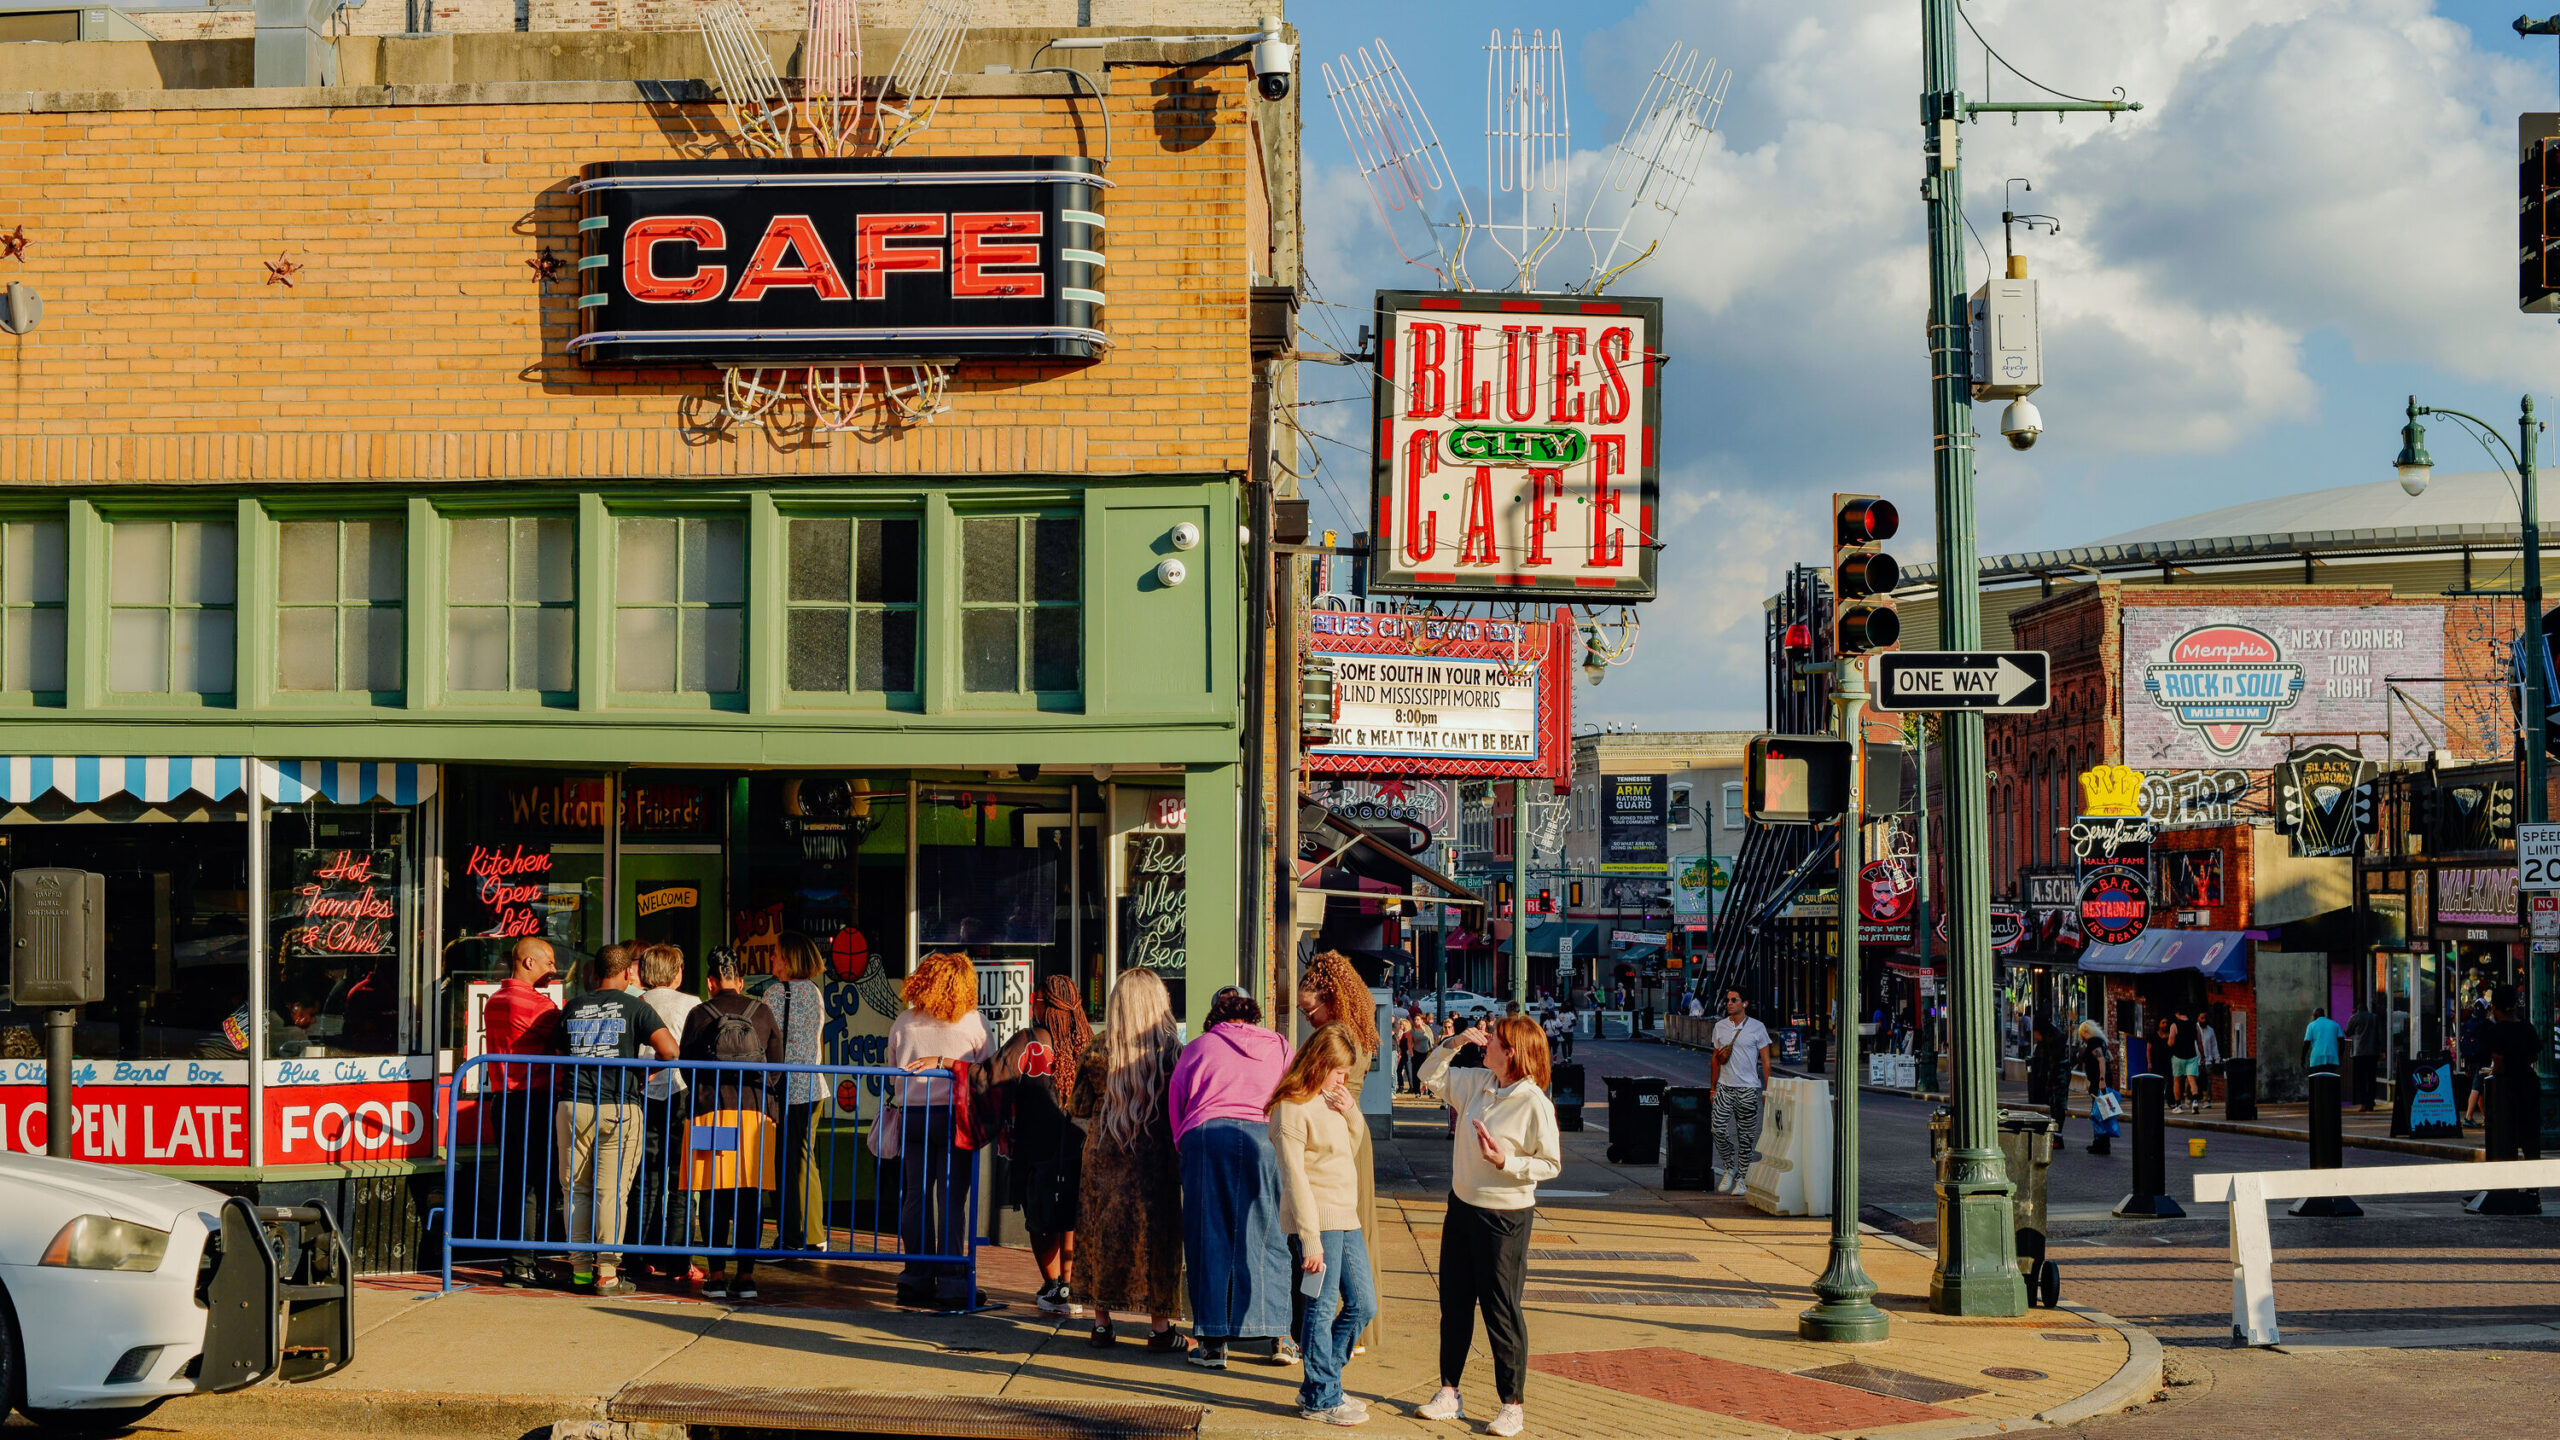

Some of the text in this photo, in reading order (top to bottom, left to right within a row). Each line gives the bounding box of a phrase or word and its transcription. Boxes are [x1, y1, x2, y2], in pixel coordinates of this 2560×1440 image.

[623, 211, 1045, 303] CAFE
[1403, 322, 1631, 424] BLUES
[1454, 429, 1580, 460] CITY
[1402, 429, 1626, 567] CAFE
[1312, 614, 1527, 643] BLUES CITY BAND BOX
[2291, 629, 2405, 649] NEXT CORNER
[2182, 641, 2269, 663] Memphis
[1340, 663, 1533, 688] SOME SOUTH IN YOUR MOUTH
[2328, 655, 2369, 675] TURN
[1900, 671, 1999, 692] ONE WAY
[2164, 673, 2284, 697] ROCK n SOUL
[2326, 679, 2373, 698] RIGHT
[1380, 687, 1450, 706] MISSISSIPPI
[1453, 690, 1501, 708] MORRIS
[1395, 709, 1438, 726] 8:00pm
[2190, 708, 2261, 719] MUSEUM
[1330, 728, 1531, 751] SIC & MEAT THAT CAN'T BE BEAT
[2304, 762, 2349, 774] BLACK
[1616, 786, 1652, 795] ARMY
[2301, 774, 2353, 787] DIAMOND
[637, 789, 701, 826] Friends
[2070, 818, 2157, 858] Jerry Lawler
[467, 844, 552, 876] Kitchen
[1142, 835, 1186, 873] Bes
[2084, 857, 2145, 865] HALL OF FAME
[2528, 846, 2560, 856] LIMIT
[319, 849, 372, 882] Hot
[2525, 859, 2560, 882] 20
[481, 873, 542, 914] Open
[2099, 876, 2135, 891] BAR
[2438, 867, 2519, 916] WALKING
[303, 886, 395, 920] Tamales
[638, 890, 691, 914] WELCOME
[2081, 900, 2147, 919] RESTAURANT
[2538, 900, 2555, 910] NO
[489, 907, 541, 938] Late
[734, 902, 784, 943] HOT
[2087, 920, 2143, 944] 159 BEALE
[2467, 929, 2488, 940] ENTER
[302, 920, 380, 954] & Chili
[1138, 930, 1186, 969] Bea
[978, 970, 1024, 1006] LUES
[824, 1015, 890, 1080] Tiger
[70, 1063, 97, 1087] afe
[113, 1063, 170, 1082] Band
[187, 1062, 224, 1083] Box
[277, 1060, 411, 1084] Blue City Cafe
[144, 1104, 244, 1159] LATE
[282, 1101, 424, 1153] FOOD
